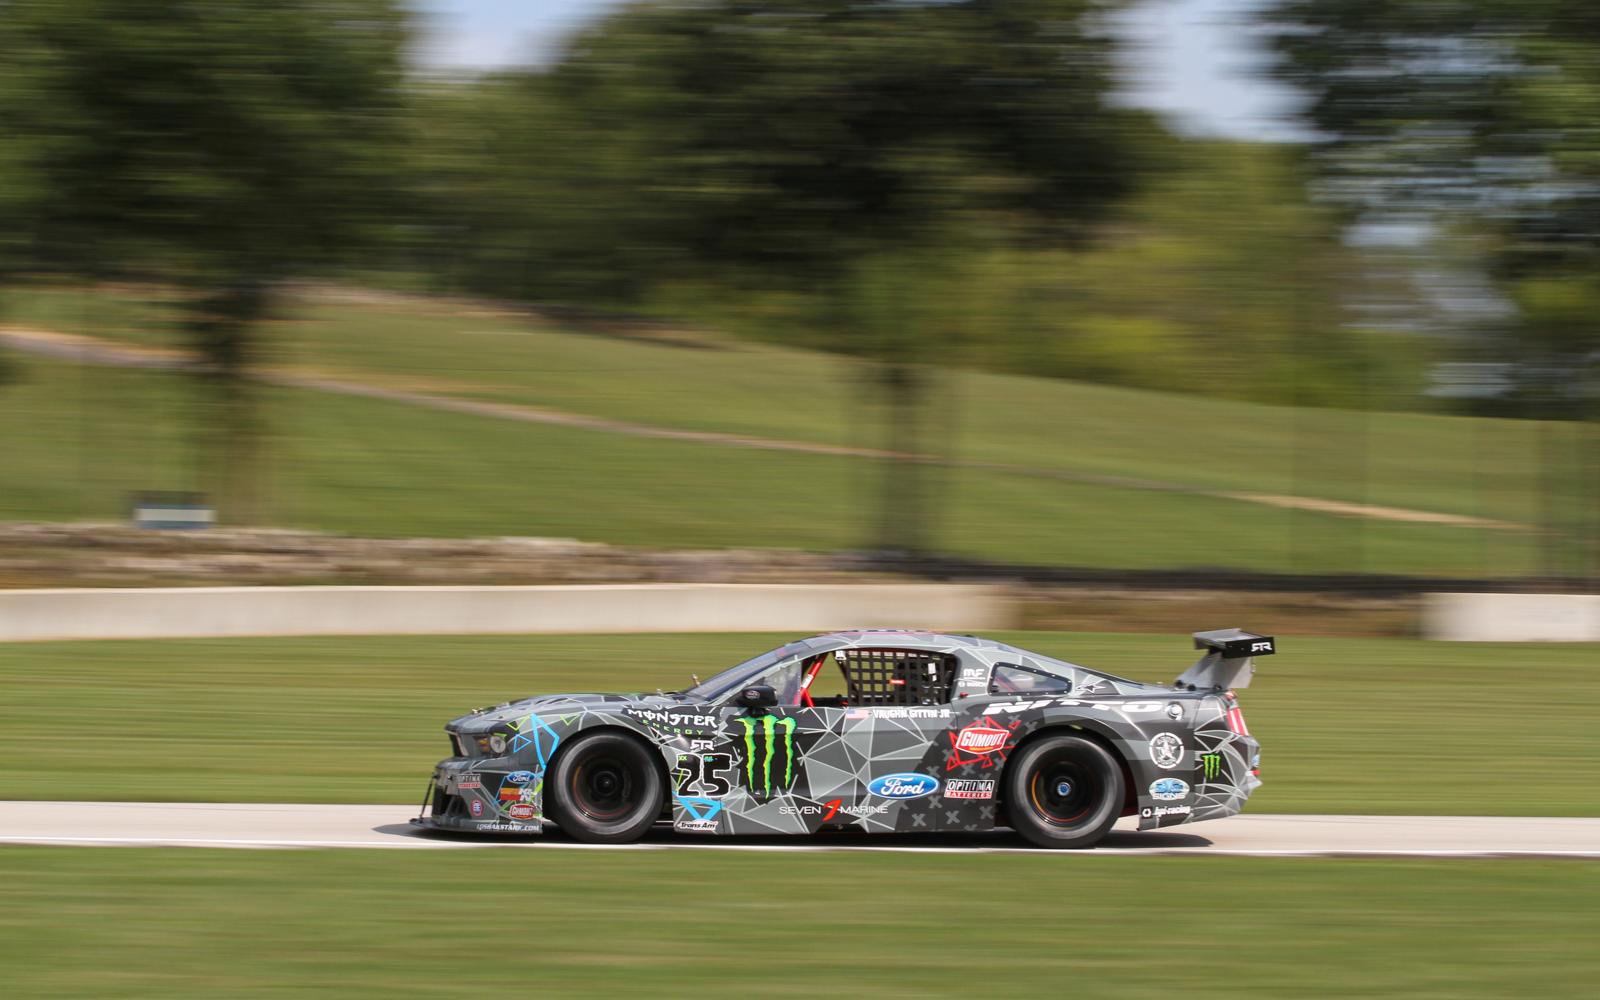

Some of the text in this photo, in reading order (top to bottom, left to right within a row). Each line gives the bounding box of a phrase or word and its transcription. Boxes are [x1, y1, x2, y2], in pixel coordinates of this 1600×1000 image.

[628, 709, 718, 728] MONSTER
[873, 709, 950, 719] VAUGHN GITTIN JR
[642, 719, 703, 735] ENERGY
[960, 731, 1006, 747] GUMOUT
[676, 752, 733, 798] 25
[880, 777, 926, 796] Ford
[948, 780, 993, 791] OPTIMA
[779, 806, 821, 815] SEVEN
[839, 805, 888, 814] MARINE
